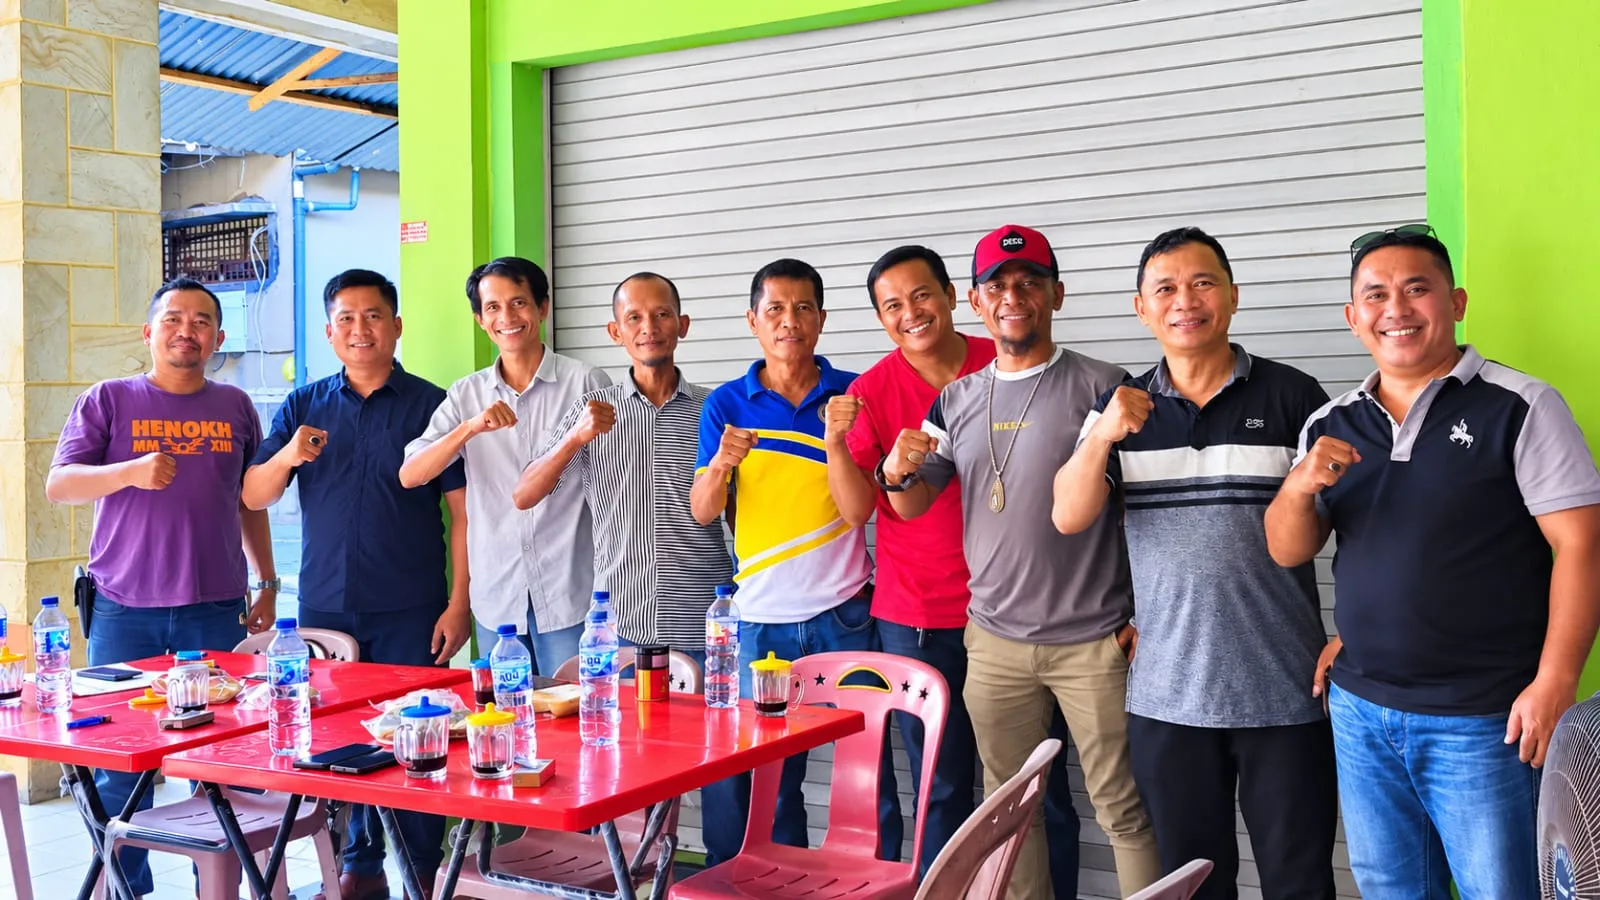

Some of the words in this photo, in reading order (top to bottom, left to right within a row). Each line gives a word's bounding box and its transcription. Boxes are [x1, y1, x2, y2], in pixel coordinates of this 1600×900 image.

[132, 419, 232, 438] HENOKH
[132, 440, 159, 452] MM
[211, 440, 232, 452] XIII
